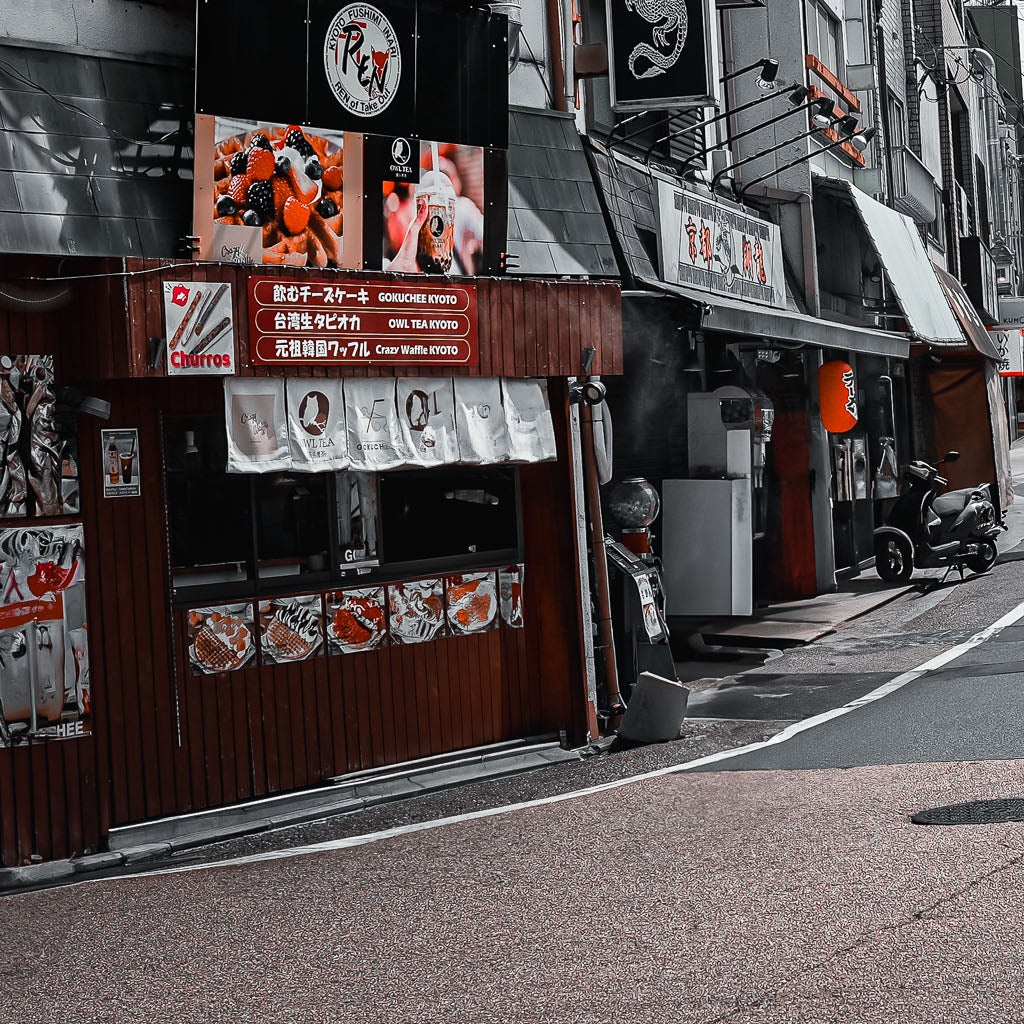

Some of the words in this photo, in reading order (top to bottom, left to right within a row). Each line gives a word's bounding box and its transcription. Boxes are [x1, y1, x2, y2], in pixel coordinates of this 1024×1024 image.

[329, 17, 346, 51] KYOTO
[348, 8, 382, 26] FUSHIMI
[383, 26, 397, 58] INARI
[335, 82, 350, 104] REN
[350, 100, 359, 109] of
[361, 101, 378, 112] Take
[273, 284, 369, 305] 飲むチーズケーキ
[378, 292, 426, 303] GOKUCHEE
[428, 294, 457, 304] KYOTO
[274, 312, 361, 331] 台湾生タピオカ
[388, 318, 410, 329] OWL
[411, 319, 428, 329] TEA
[429, 319, 458, 329] KYOTO
[275, 338, 370, 358] 元祖韓国ワッフル
[375, 344, 399, 356] Crazy
[401, 345, 428, 355] Waffle
[429, 345, 458, 355] KYOTO
[170, 351, 231, 368] Churros
[319, 437, 336, 448] TEA
